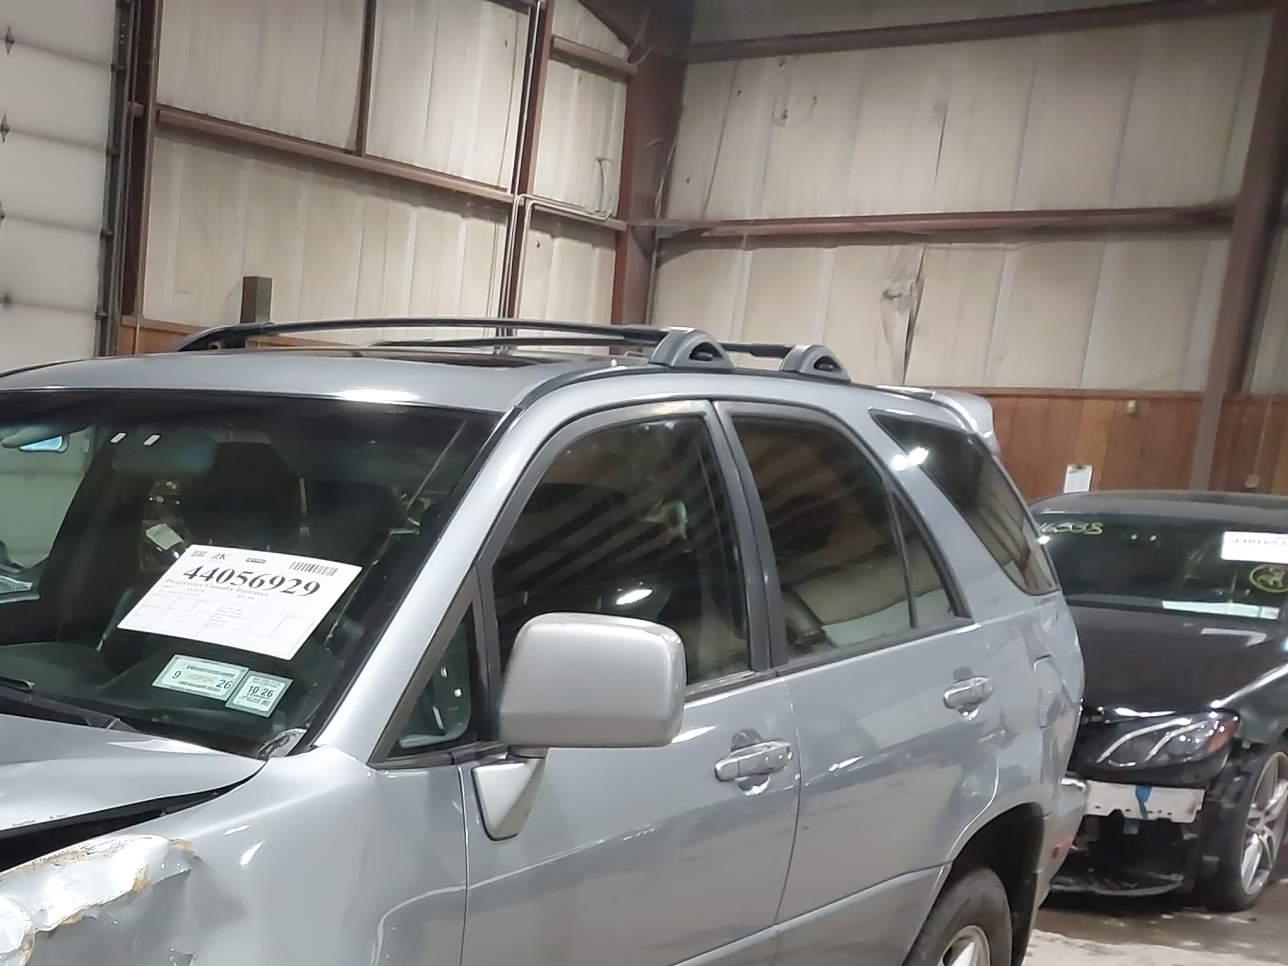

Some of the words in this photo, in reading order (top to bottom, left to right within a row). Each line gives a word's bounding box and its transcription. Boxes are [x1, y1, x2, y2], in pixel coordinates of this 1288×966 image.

[183, 564, 321, 597] 44056929
[172, 670, 182, 680] 9
[216, 679, 233, 690] 26
[248, 685, 260, 694] 10
[261, 687, 274, 698] 26
